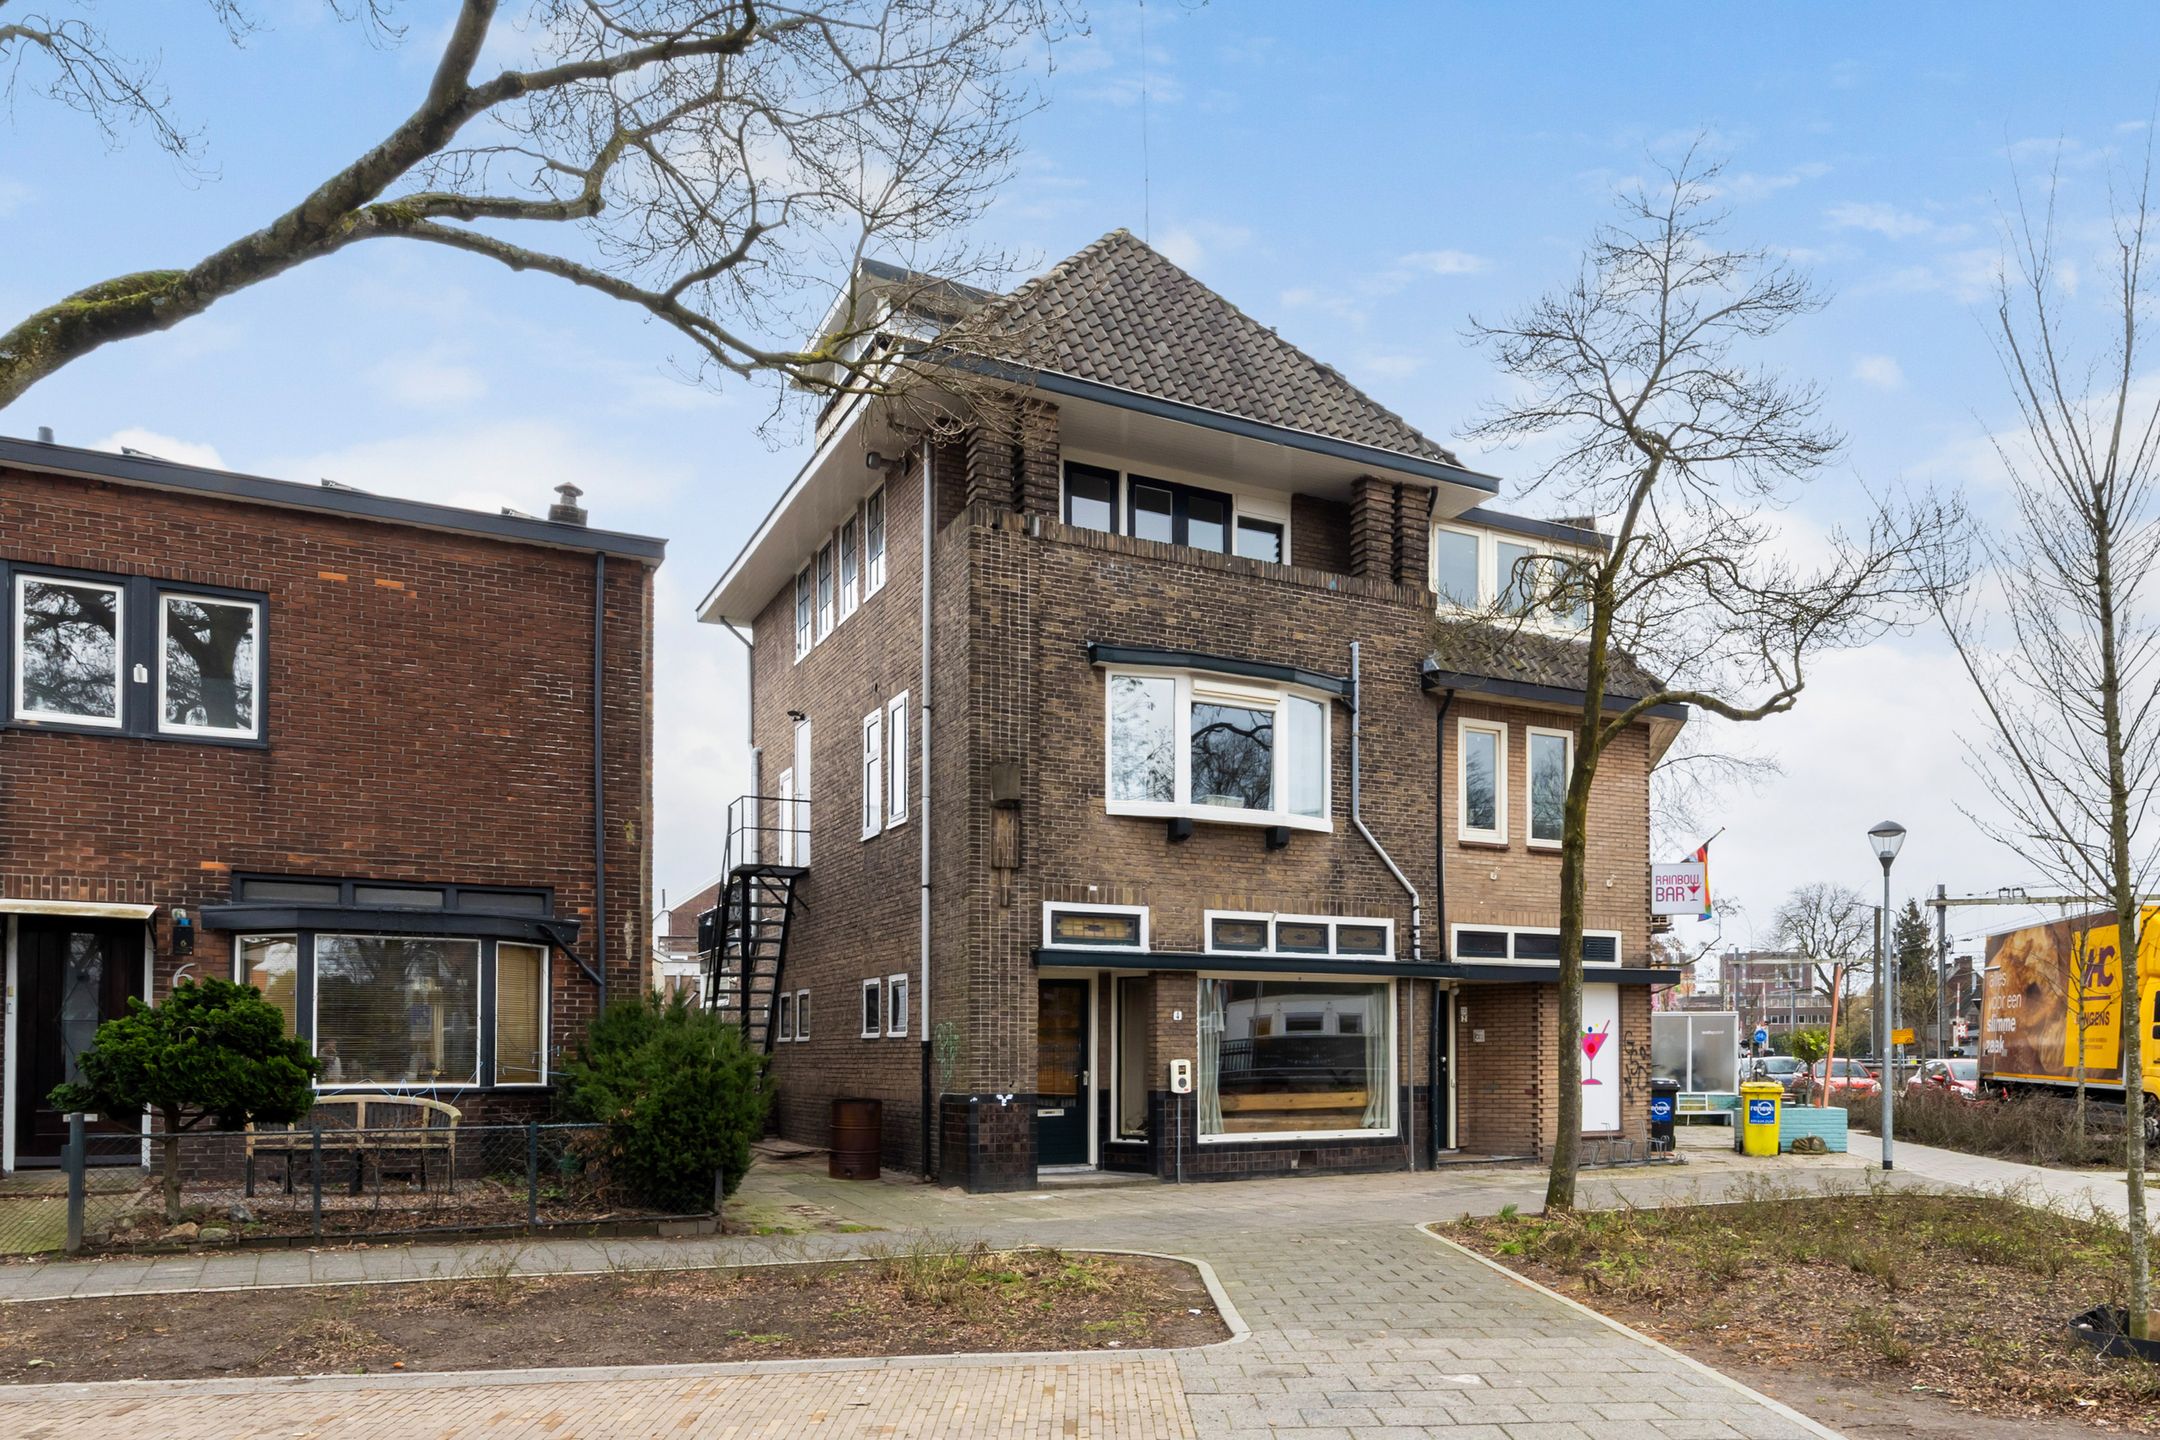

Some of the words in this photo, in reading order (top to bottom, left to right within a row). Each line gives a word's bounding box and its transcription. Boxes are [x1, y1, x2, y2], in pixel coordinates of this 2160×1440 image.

[1655, 874, 1699, 885] RAINBOW
[1655, 886, 1685, 902] BAR
[2007, 993, 2022, 1008] een
[1986, 1013, 2016, 1032] slimme
